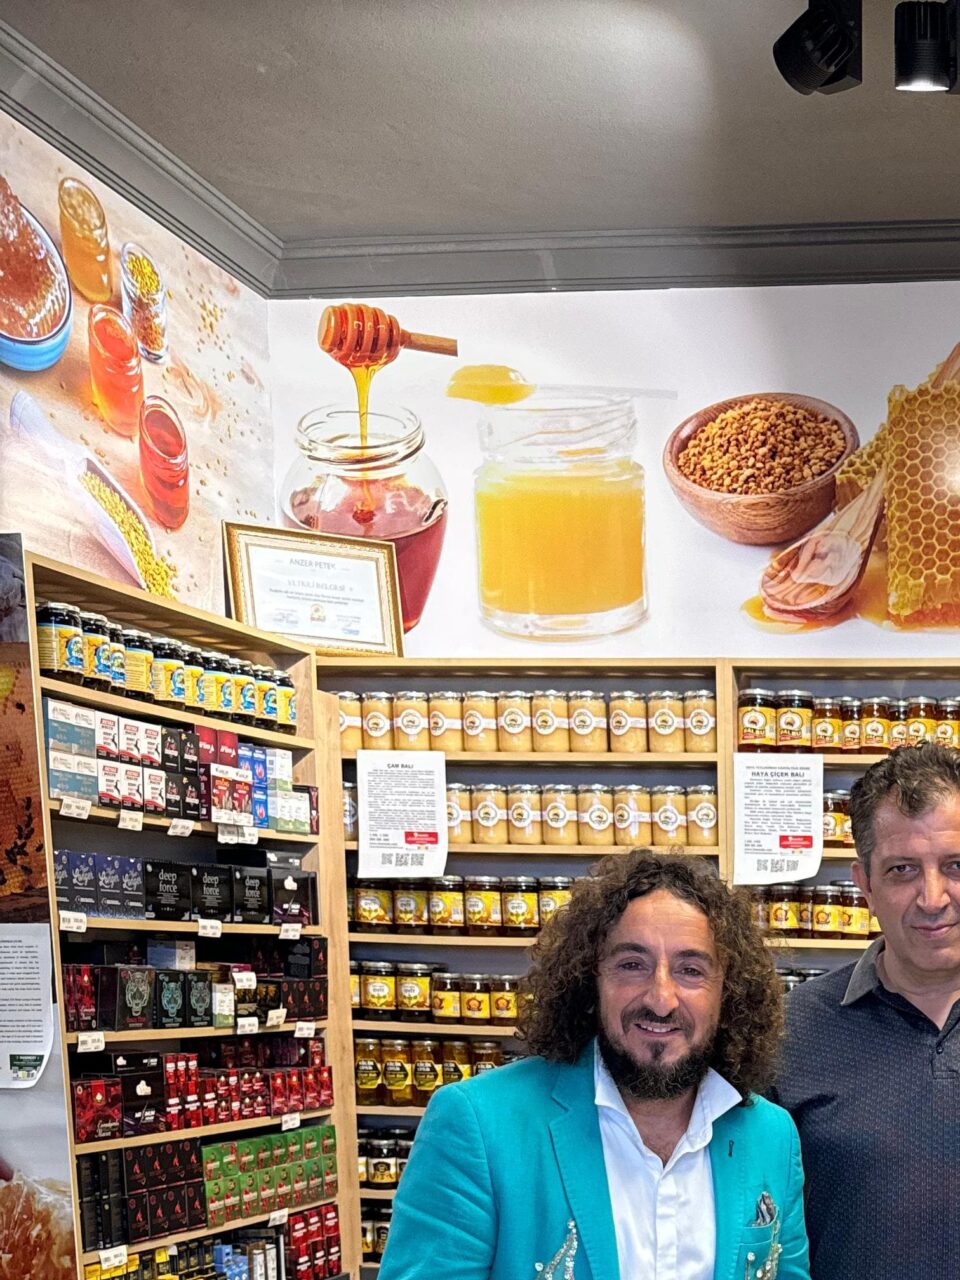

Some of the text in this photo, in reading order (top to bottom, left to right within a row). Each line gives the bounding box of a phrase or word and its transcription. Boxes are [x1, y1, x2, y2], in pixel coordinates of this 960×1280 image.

[159, 869, 177, 883] deep
[203, 872, 219, 884] deep
[159, 883, 178, 893] force
[203, 886, 220, 896] force
